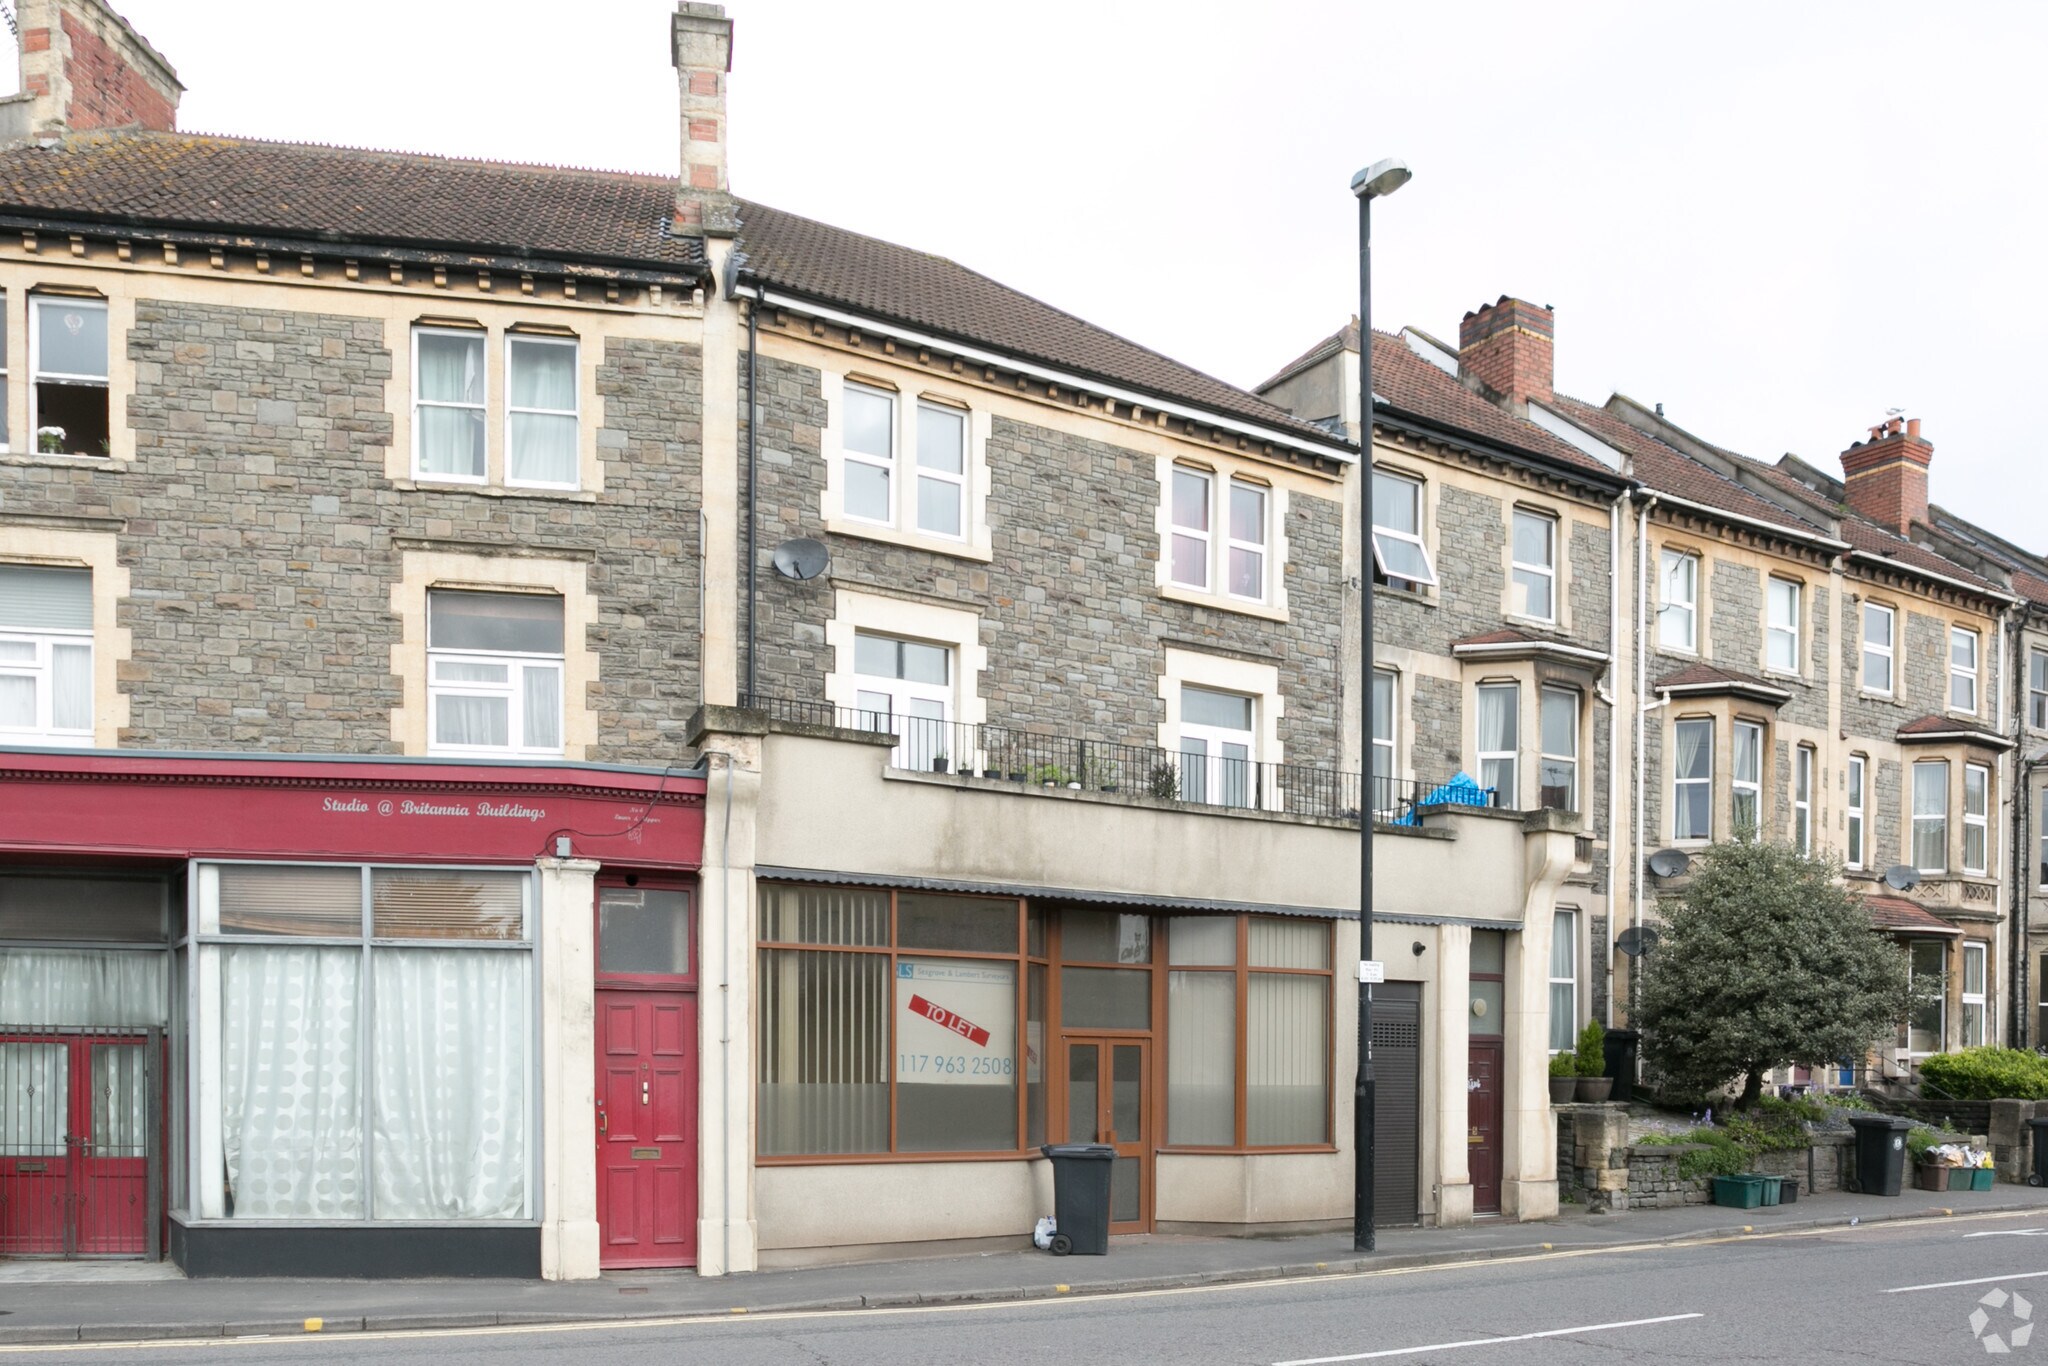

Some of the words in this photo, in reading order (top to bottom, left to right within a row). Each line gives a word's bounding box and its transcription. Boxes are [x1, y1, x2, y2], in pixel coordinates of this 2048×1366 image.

[322, 797, 369, 812] Studio
[377, 799, 394, 817] @
[400, 800, 470, 816] Britannia
[476, 802, 546, 822] Buildings
[926, 1003, 945, 1023] TO
[948, 1015, 977, 1038] LET
[900, 1054, 929, 1072] 117
[934, 1055, 966, 1073] 963
[972, 1057, 1012, 1075] 2508
